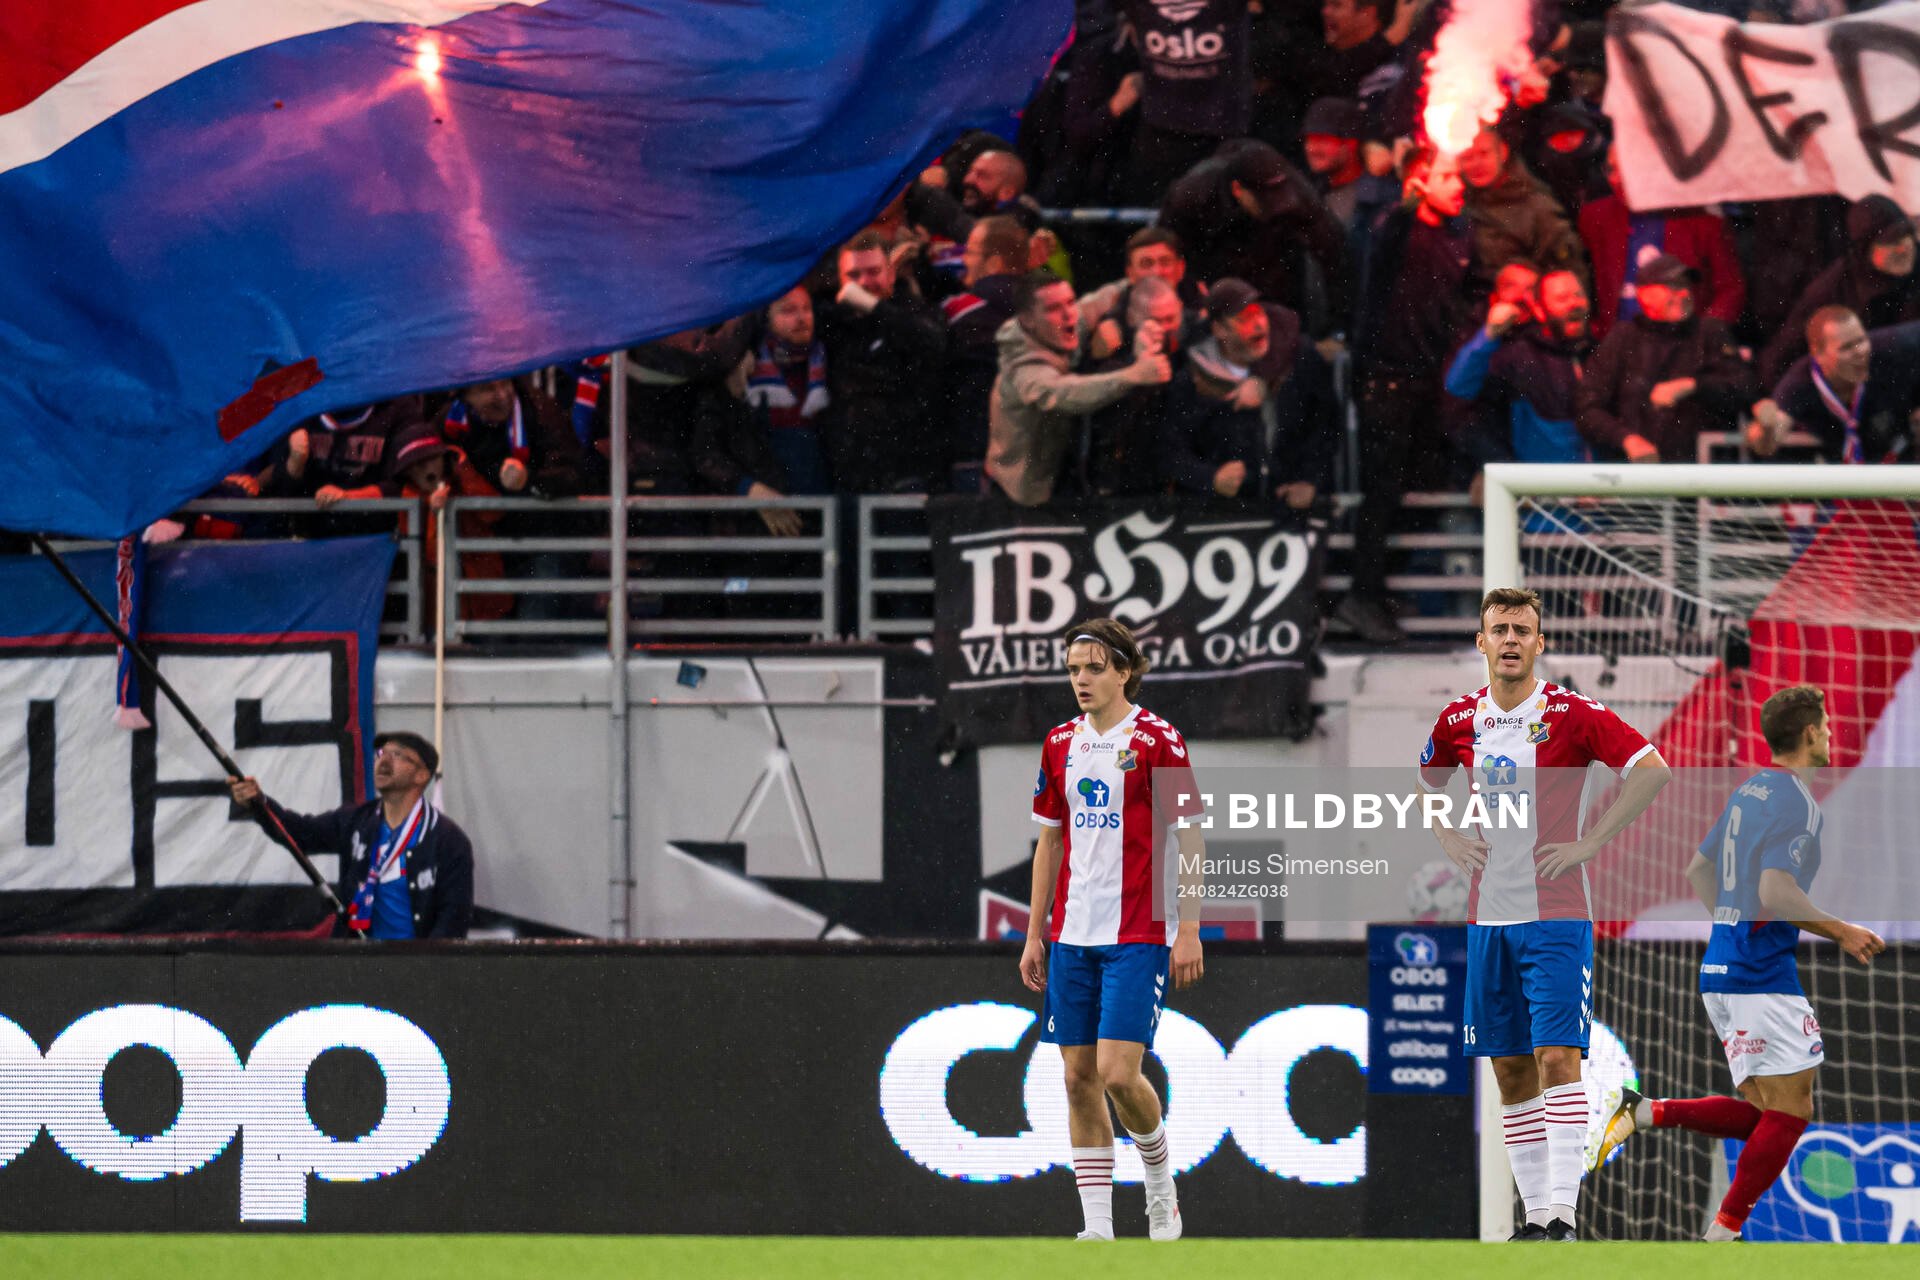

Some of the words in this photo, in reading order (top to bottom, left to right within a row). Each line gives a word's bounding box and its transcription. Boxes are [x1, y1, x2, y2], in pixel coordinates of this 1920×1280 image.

[1145, 28, 1223, 58] oslo
[1604, 12, 1920, 184] DER
[960, 634, 1192, 676] VÅLERGA
[1204, 621, 1300, 665] OSLO
[1447, 708, 1475, 726] IT.NO
[1075, 813, 1120, 829] OBOS
[1723, 805, 1742, 892] 6
[1390, 967, 1447, 986] OBOS
[1047, 1015, 1055, 1033] 6
[1463, 1024, 1476, 1045] 16
[1391, 1067, 1447, 1087] coop
